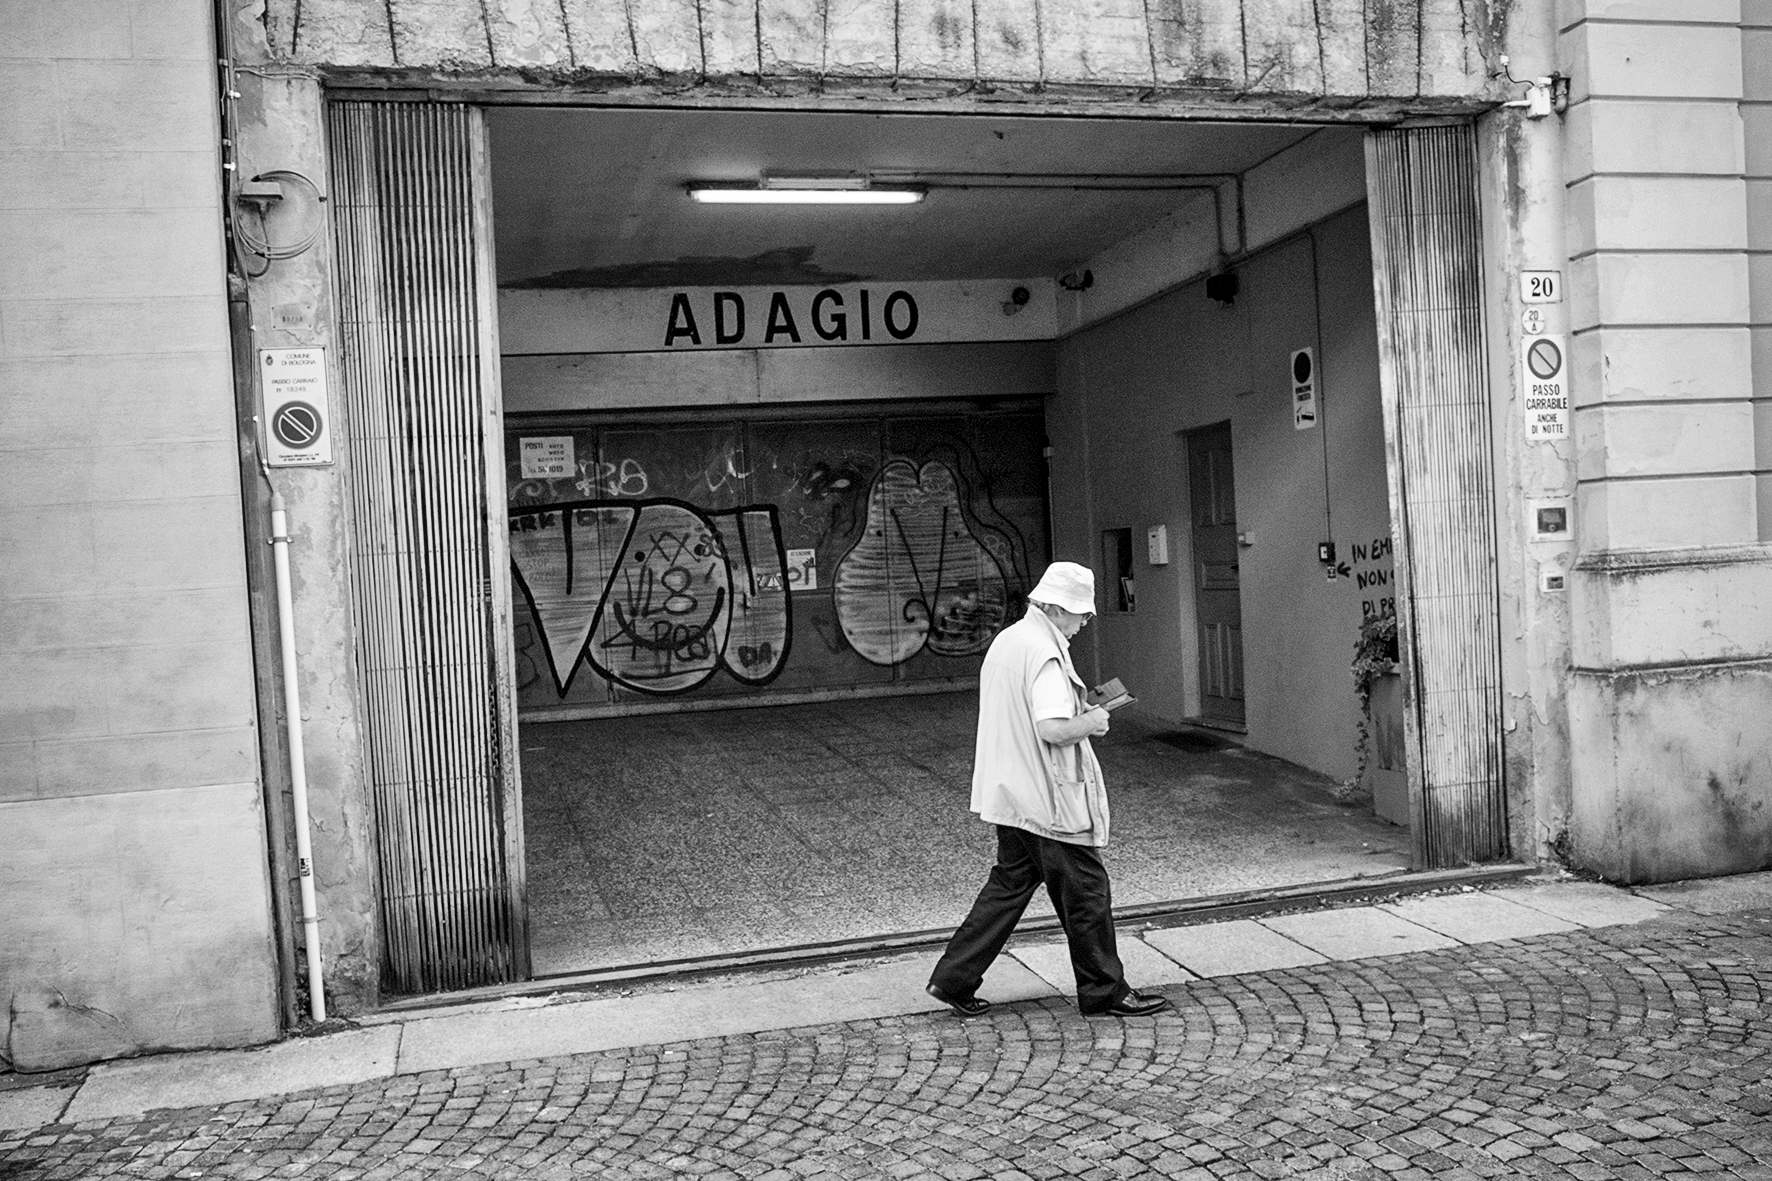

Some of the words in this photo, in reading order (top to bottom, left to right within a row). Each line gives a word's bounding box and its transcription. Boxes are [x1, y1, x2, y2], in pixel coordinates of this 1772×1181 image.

[1531, 277, 1553, 297] 20
[664, 289, 919, 346] ADAGIO
[1529, 310, 1539, 321] 20
[1531, 322, 1537, 332] A
[1532, 384, 1560, 396] PASSO
[1526, 397, 1568, 410] CARRABILE
[1537, 413, 1557, 423] ANCHE
[1532, 424, 1538, 434] DI
[1542, 423, 1563, 434] NOTTE
[524, 442, 544, 450] POSTI
[1352, 544, 1367, 564] IN
[1357, 569, 1387, 590] NON
[1362, 599, 1376, 616] DI
